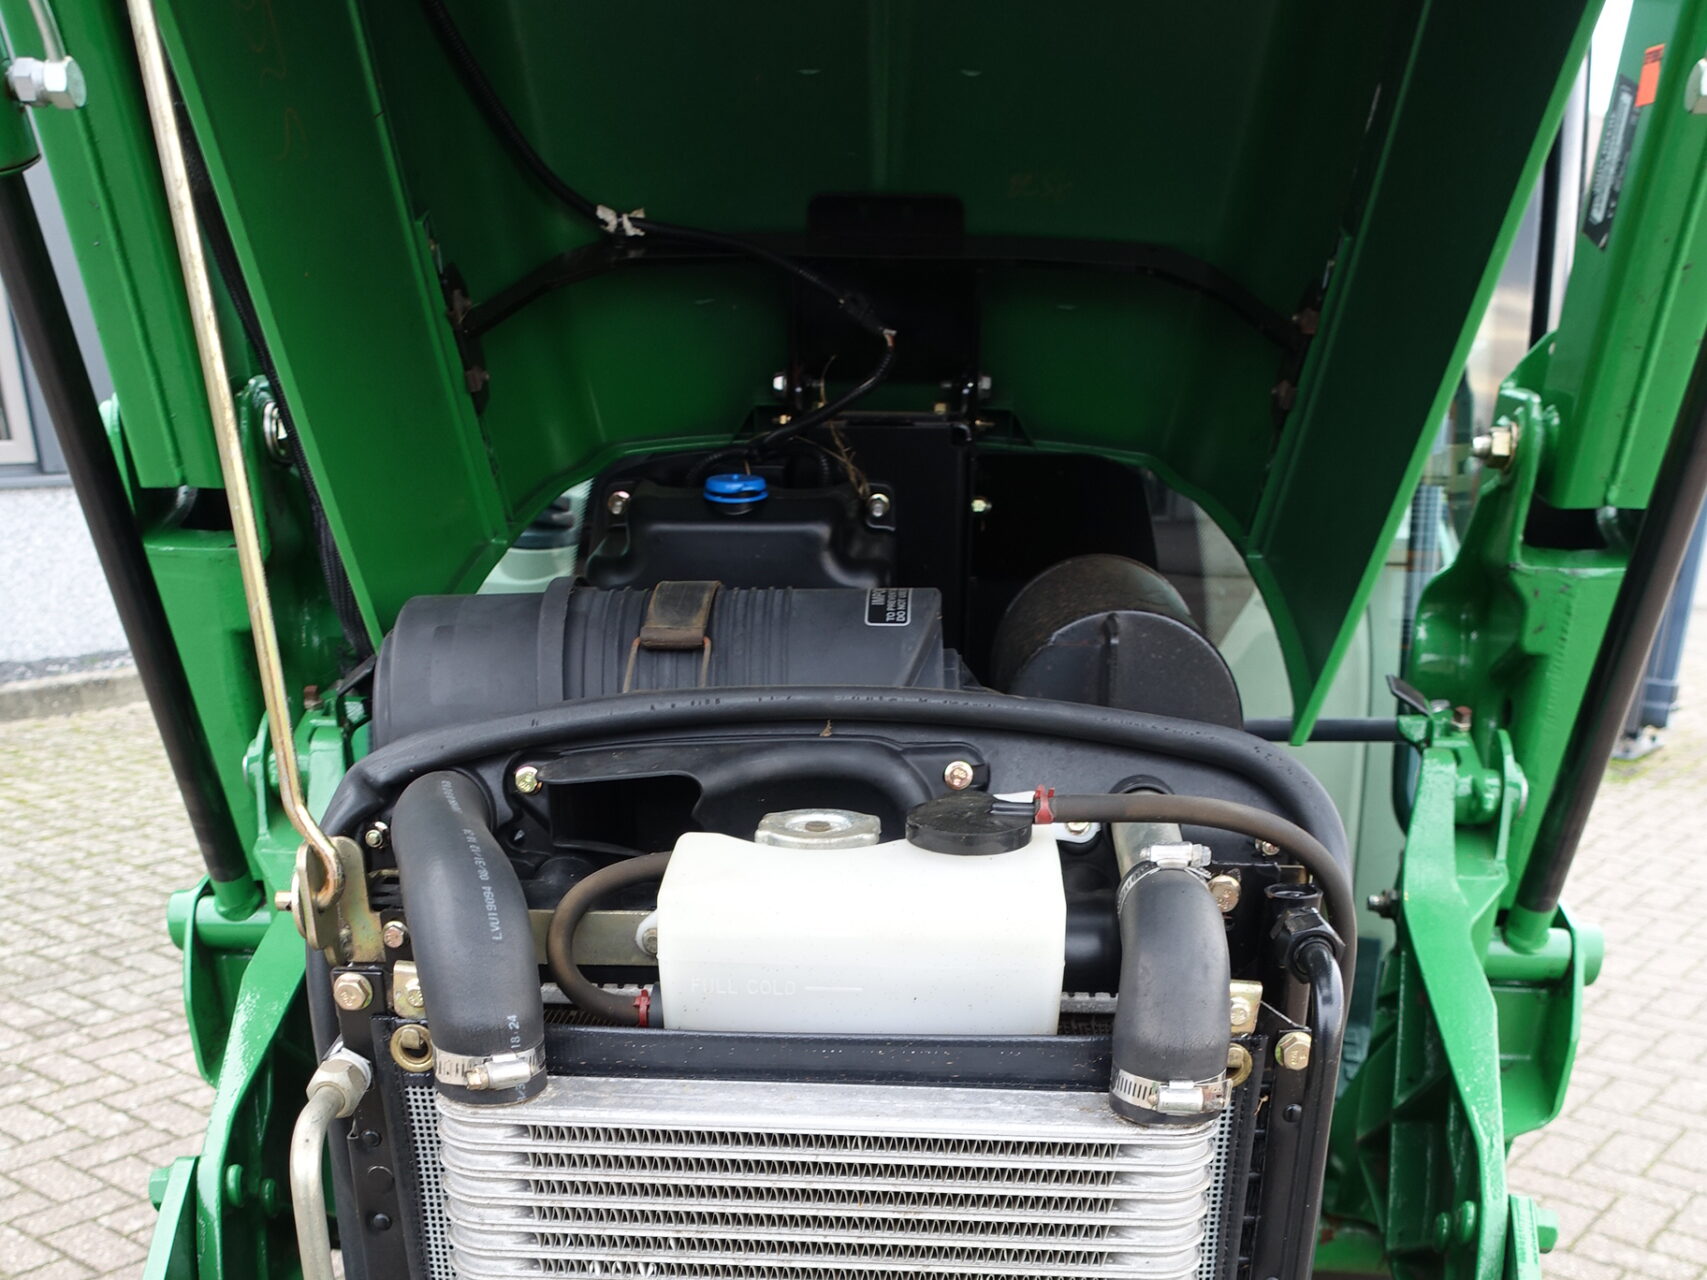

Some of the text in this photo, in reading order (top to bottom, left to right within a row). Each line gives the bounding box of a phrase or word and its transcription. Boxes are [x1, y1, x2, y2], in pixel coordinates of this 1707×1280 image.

[885, 611, 896, 622] TO
[896, 610, 906, 622] DO
[481, 885, 502, 940] LVU19094
[691, 978, 796, 995] FULL COLD
